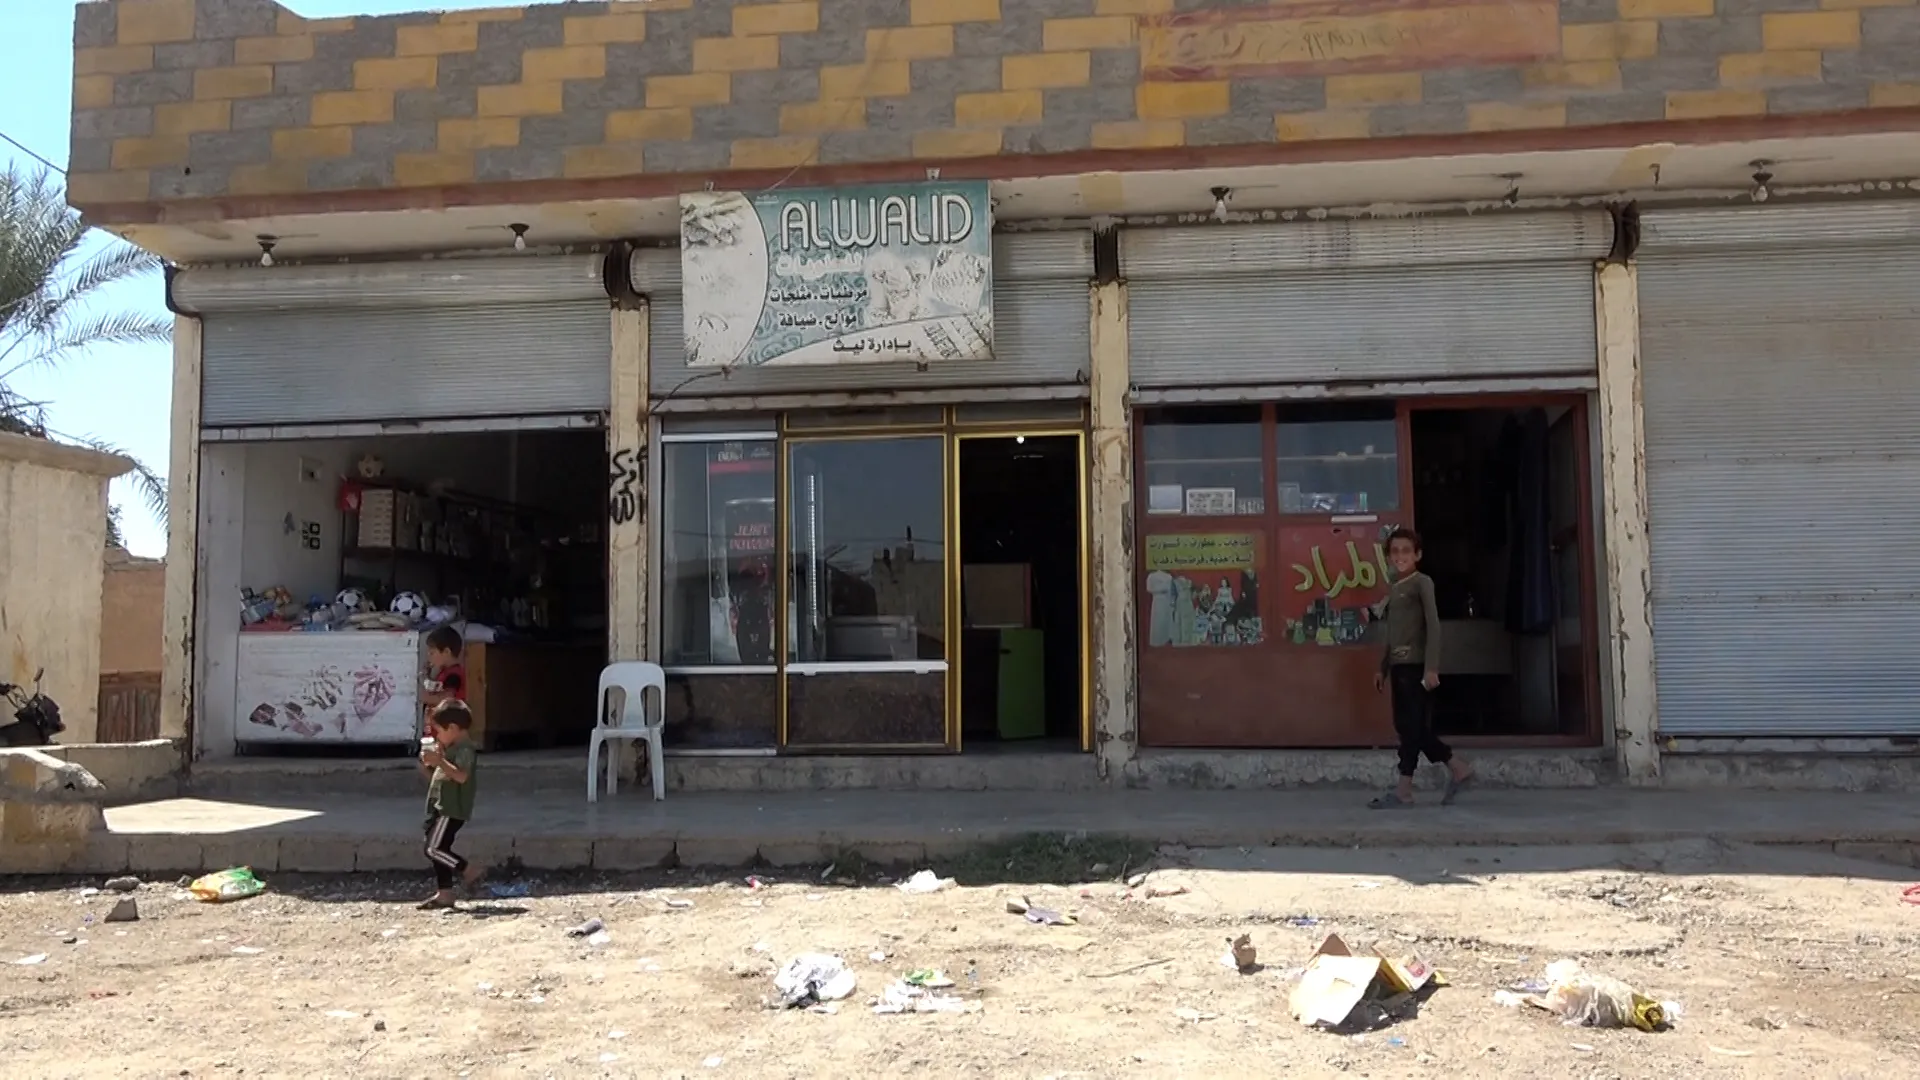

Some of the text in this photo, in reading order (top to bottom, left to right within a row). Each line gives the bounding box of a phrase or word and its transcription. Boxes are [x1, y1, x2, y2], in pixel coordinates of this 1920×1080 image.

[779, 193, 973, 251] ALWALID
[769, 284, 868, 304] مرطبات مثلجات
[778, 312, 818, 330] ضيافة
[832, 339, 865, 356] ليث
[1292, 541, 1390, 598] المراد
